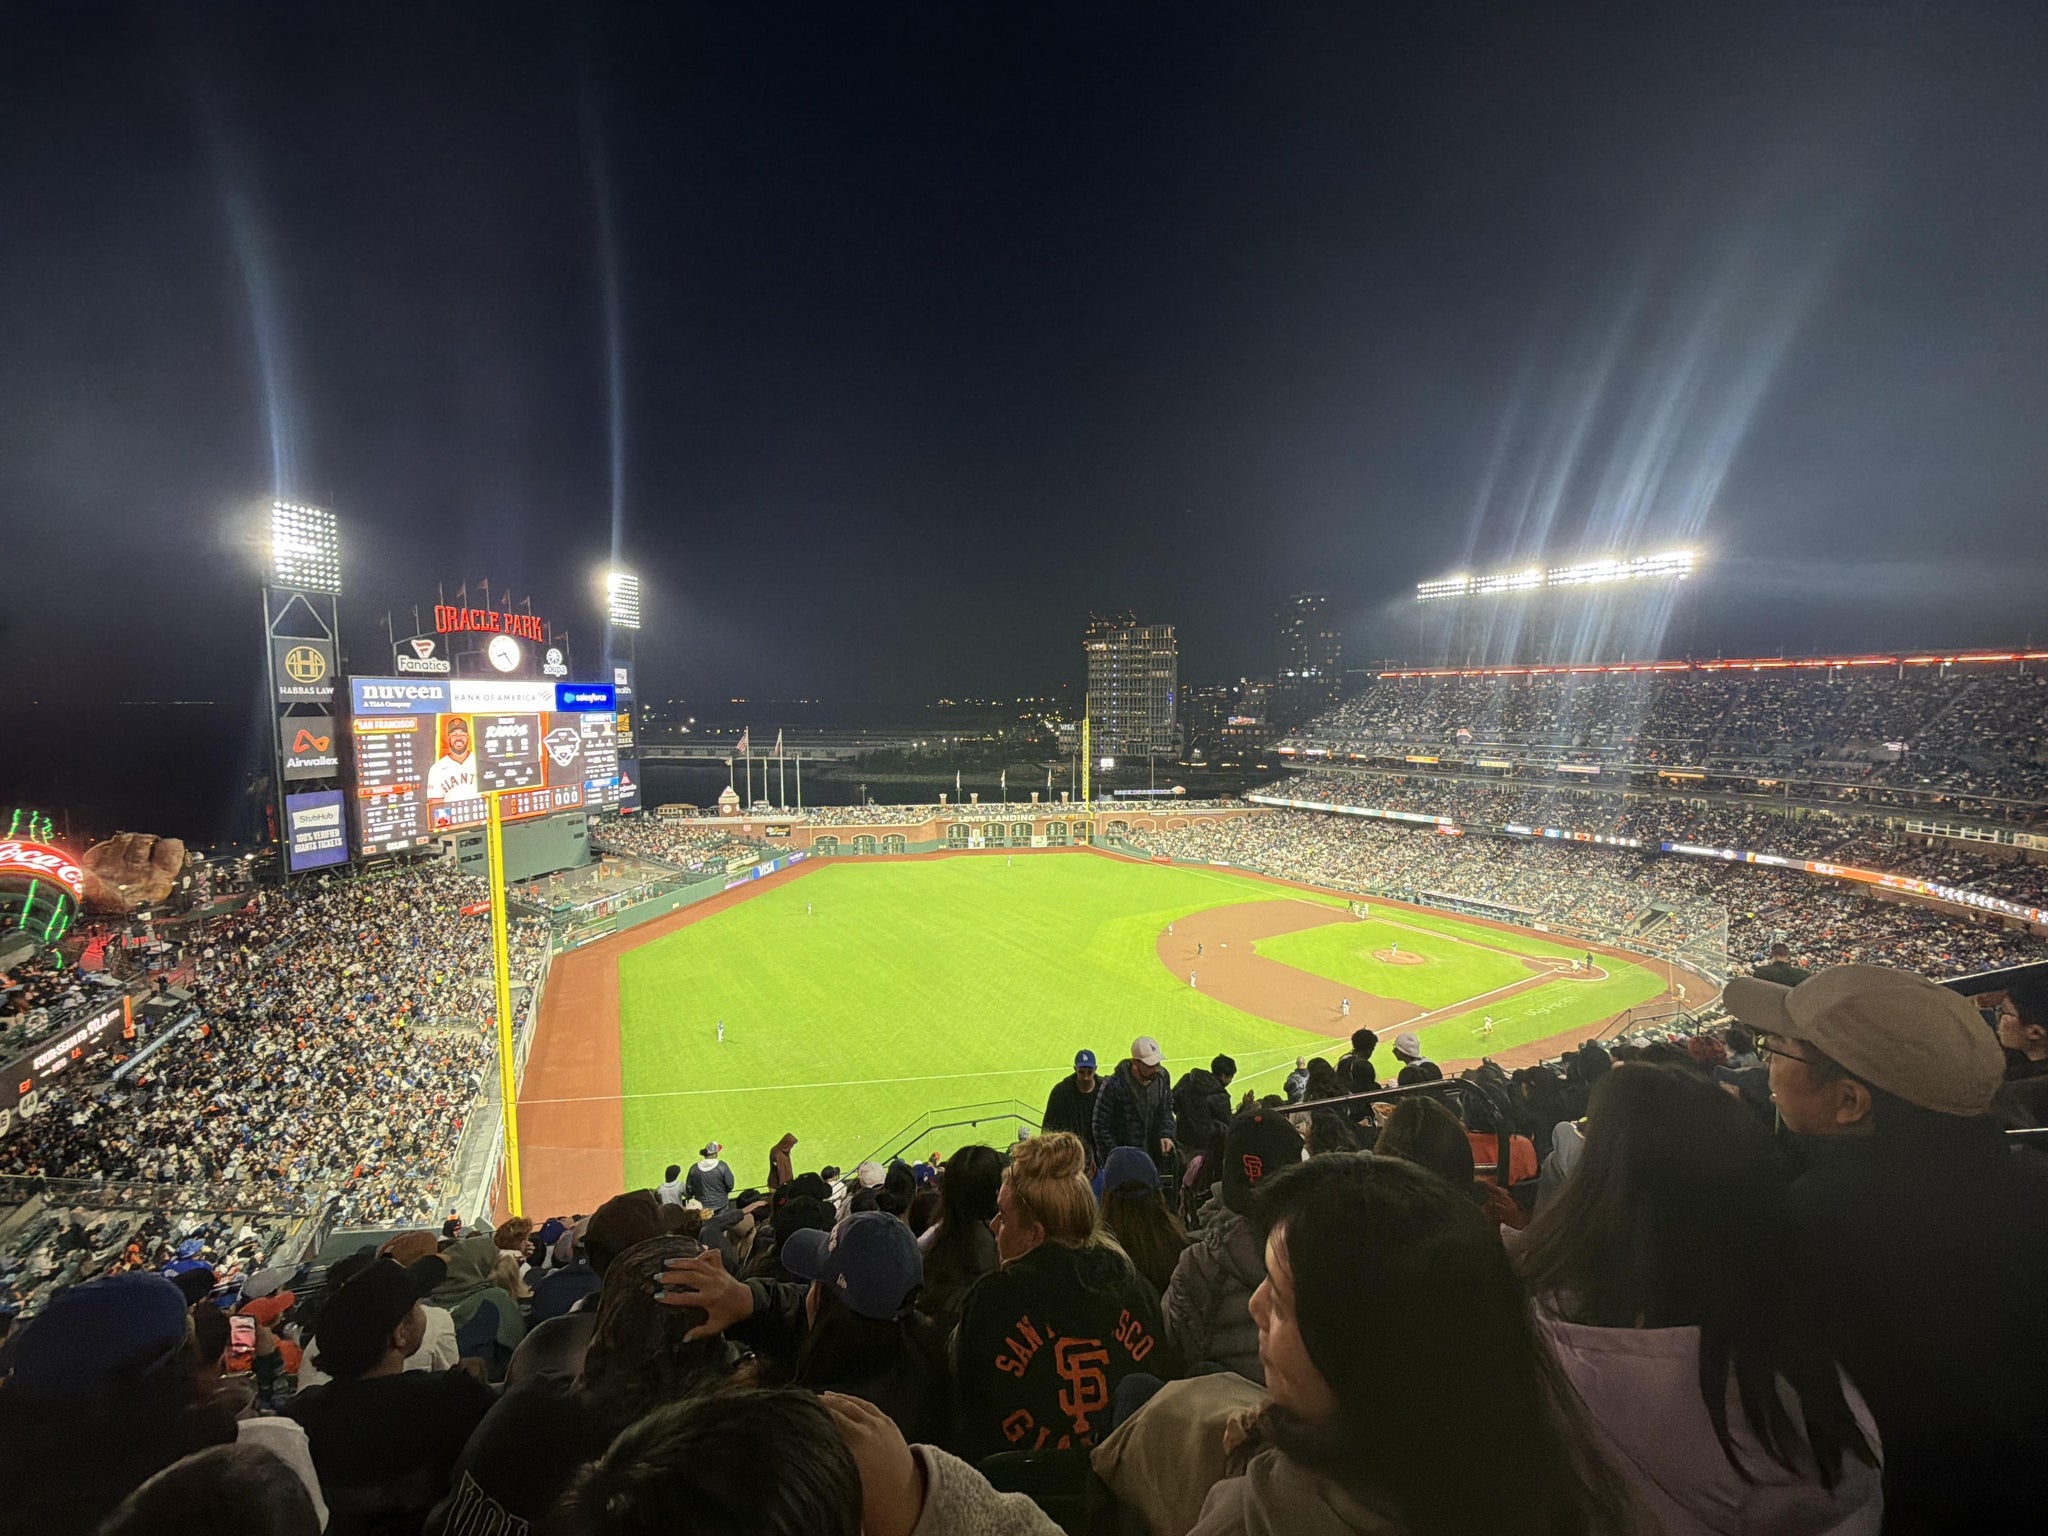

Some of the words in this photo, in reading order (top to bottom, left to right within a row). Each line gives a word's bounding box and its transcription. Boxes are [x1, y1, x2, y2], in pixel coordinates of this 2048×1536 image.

[434, 604, 500, 634] ORACLE
[503, 613, 544, 643] PARK
[399, 656, 449, 671] Fanatics
[279, 686, 315, 695] HABBAS
[316, 687, 334, 695] LAW
[362, 685, 444, 699] nuveen
[374, 720, 415, 729] FRANCISCO
[485, 724, 528, 738] RAMOS
[286, 756, 338, 768] Airwallex
[299, 813, 334, 823] StubHub
[989, 814, 1036, 822] LANDING
[313, 828, 340, 840] VERIFIED
[294, 841, 317, 853] GIANTS
[319, 837, 343, 849] TICKETS
[759, 861, 774, 876] VISA
[87, 1013, 109, 1036] 90.6
[995, 1314, 1045, 1378] SAN
